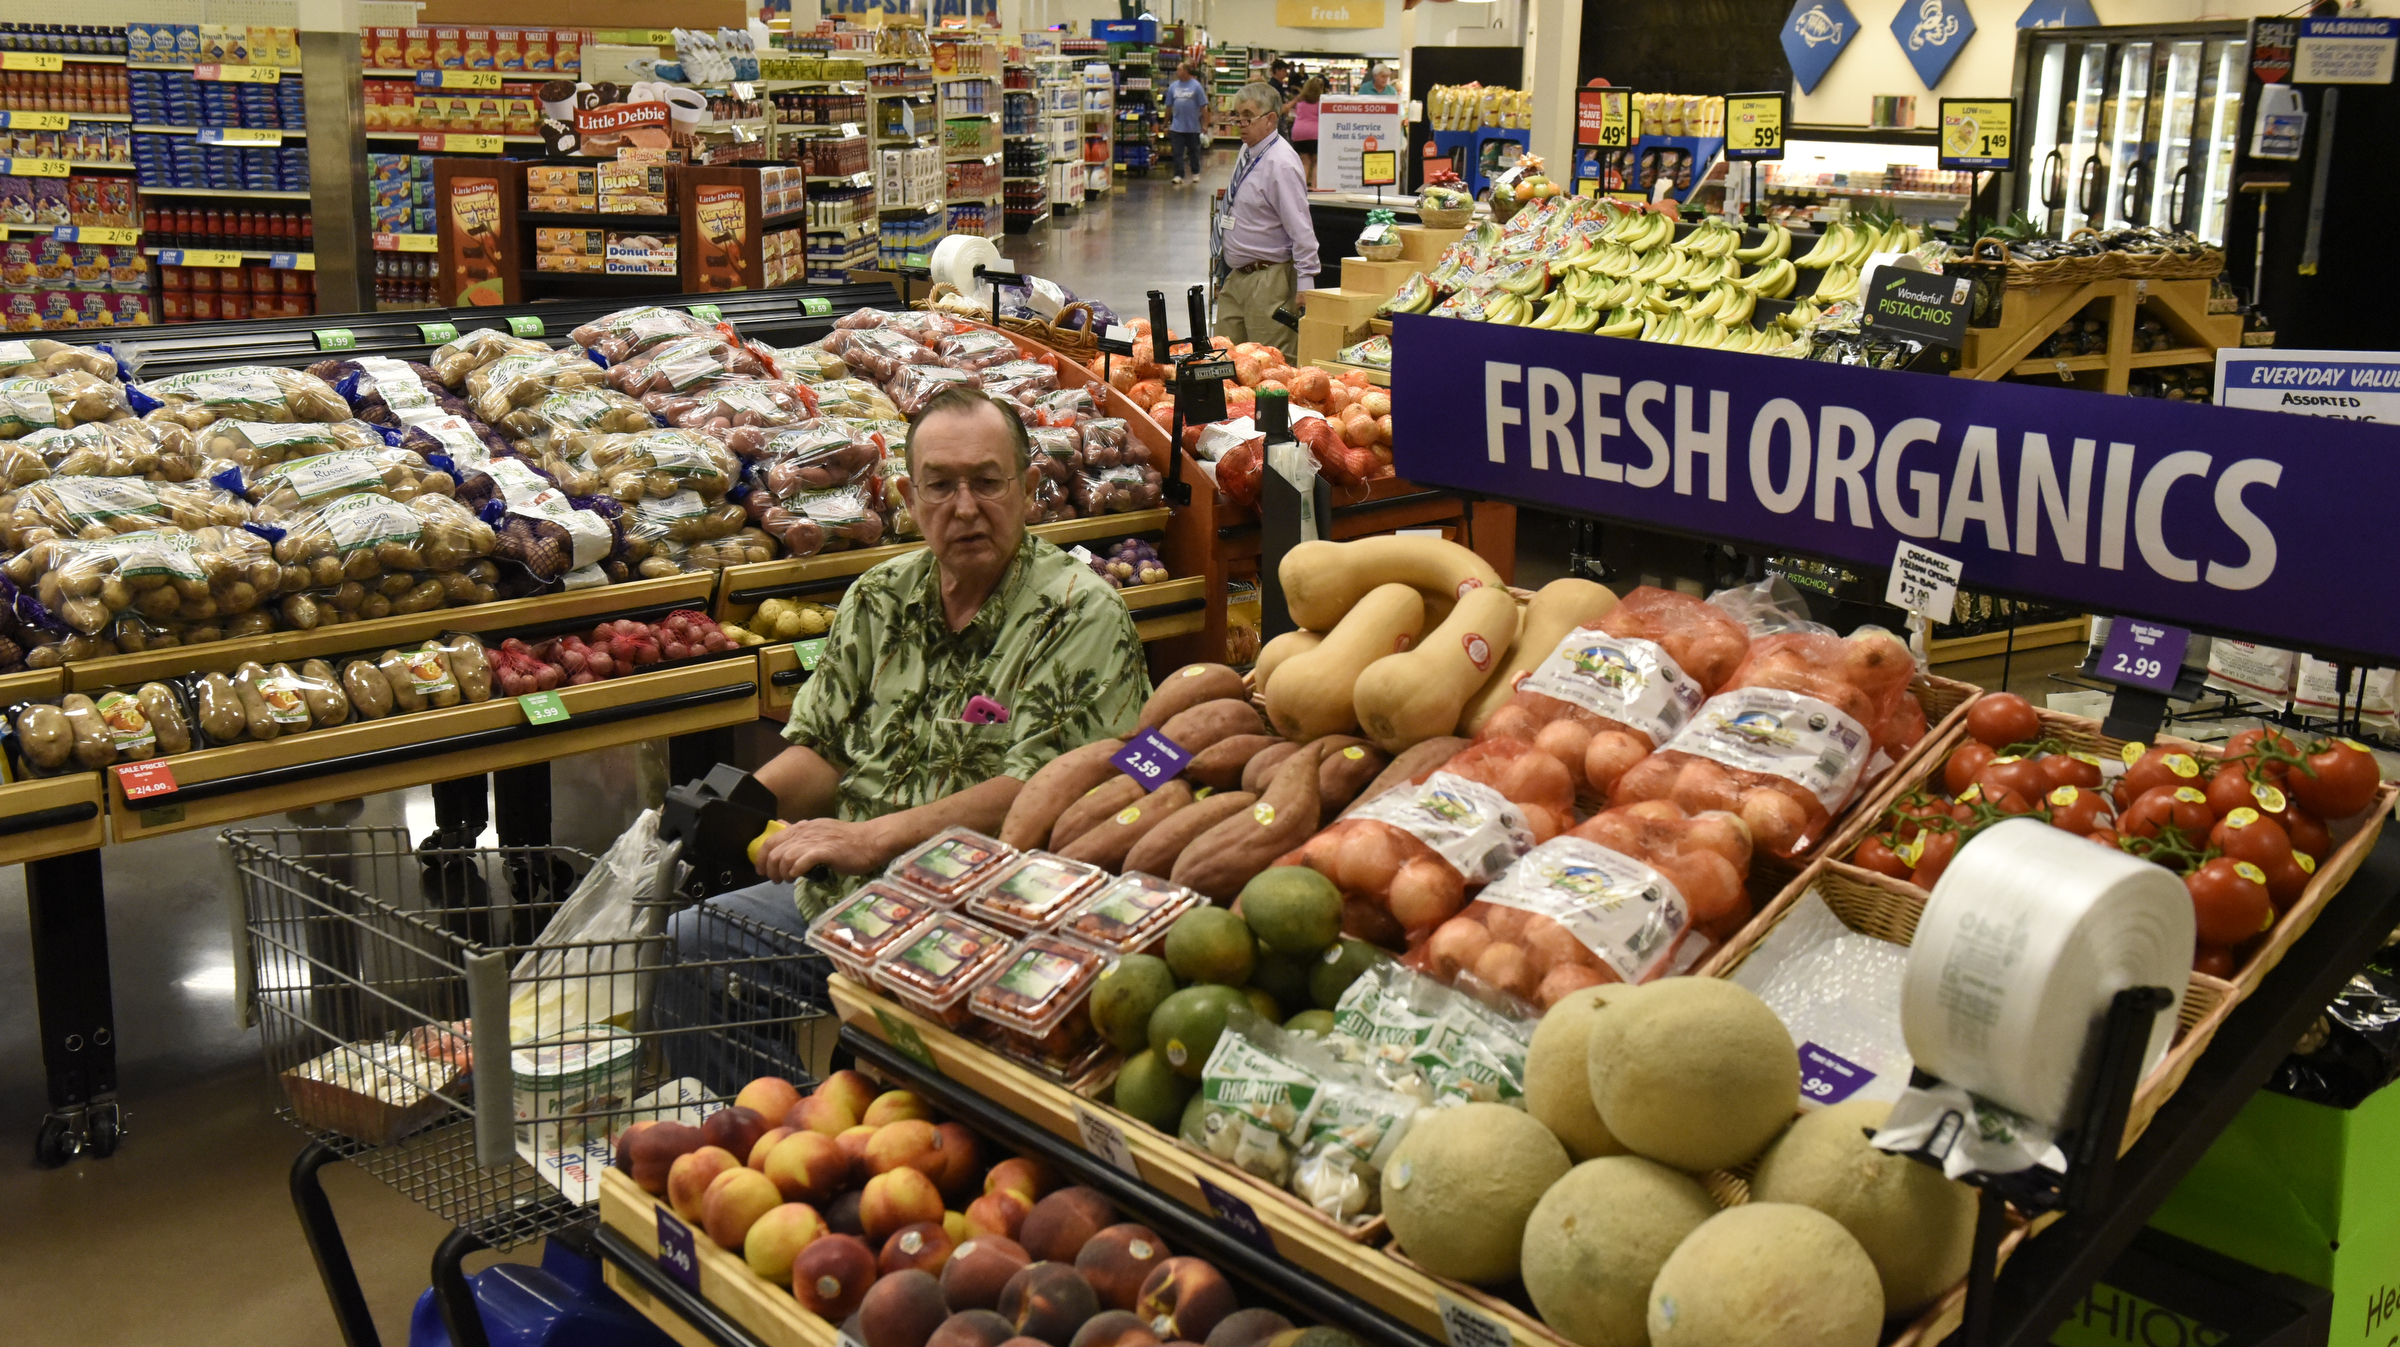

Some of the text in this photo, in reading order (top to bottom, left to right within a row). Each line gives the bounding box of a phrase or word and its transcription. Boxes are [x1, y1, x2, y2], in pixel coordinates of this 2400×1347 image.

[1311, 7, 1349, 21] Fresh
[2310, 22, 2390, 35] WARNING
[472, 74, 497, 86] 2/$6
[1332, 104, 1363, 112] COMING
[579, 107, 665, 130] Little Debbie
[1583, 111, 1601, 119] SAVE
[1336, 123, 1381, 131] Full Service
[1580, 120, 1600, 128] MORE
[1602, 126, 1626, 145] 49¢
[1755, 125, 1780, 147] 59¢
[611, 167, 635, 176] Honey
[604, 175, 640, 188] BUNS
[454, 184, 495, 195] Little Debbie
[699, 192, 741, 203] Little Debbie
[454, 200, 496, 216] Harvest
[612, 203, 636, 212] BUNS
[476, 210, 499, 222] Fun!
[699, 207, 741, 223] Harvest
[722, 217, 744, 230] Fun!
[610, 248, 648, 256] Donut
[609, 263, 648, 272] Donut
[1898, 288, 1944, 305] Wonderful
[810, 305, 827, 313] 2.69
[1879, 299, 1953, 325] PISTACHIOS
[518, 324, 538, 333] 2.99
[327, 338, 348, 347] 3.99
[431, 331, 451, 341] 3.49
[160, 370, 234, 393] Harvest
[2251, 366, 2345, 387] EVERYDAY
[2281, 392, 2361, 408] ASSORTED
[313, 465, 351, 479] Russet
[1485, 362, 2284, 591] FRESH ORGANICS
[353, 512, 391, 527] Russet
[1908, 549, 1950, 572] ORGANIC
[1787, 572, 1828, 590] PISTACHIOS
[1920, 577, 1938, 591] BAG
[806, 655, 820, 664] 3.9
[2113, 653, 2161, 679] 2.99
[534, 707, 558, 718] 3.99
[119, 761, 166, 774] SALE PRICE!
[1125, 752, 1161, 777] 2.59
